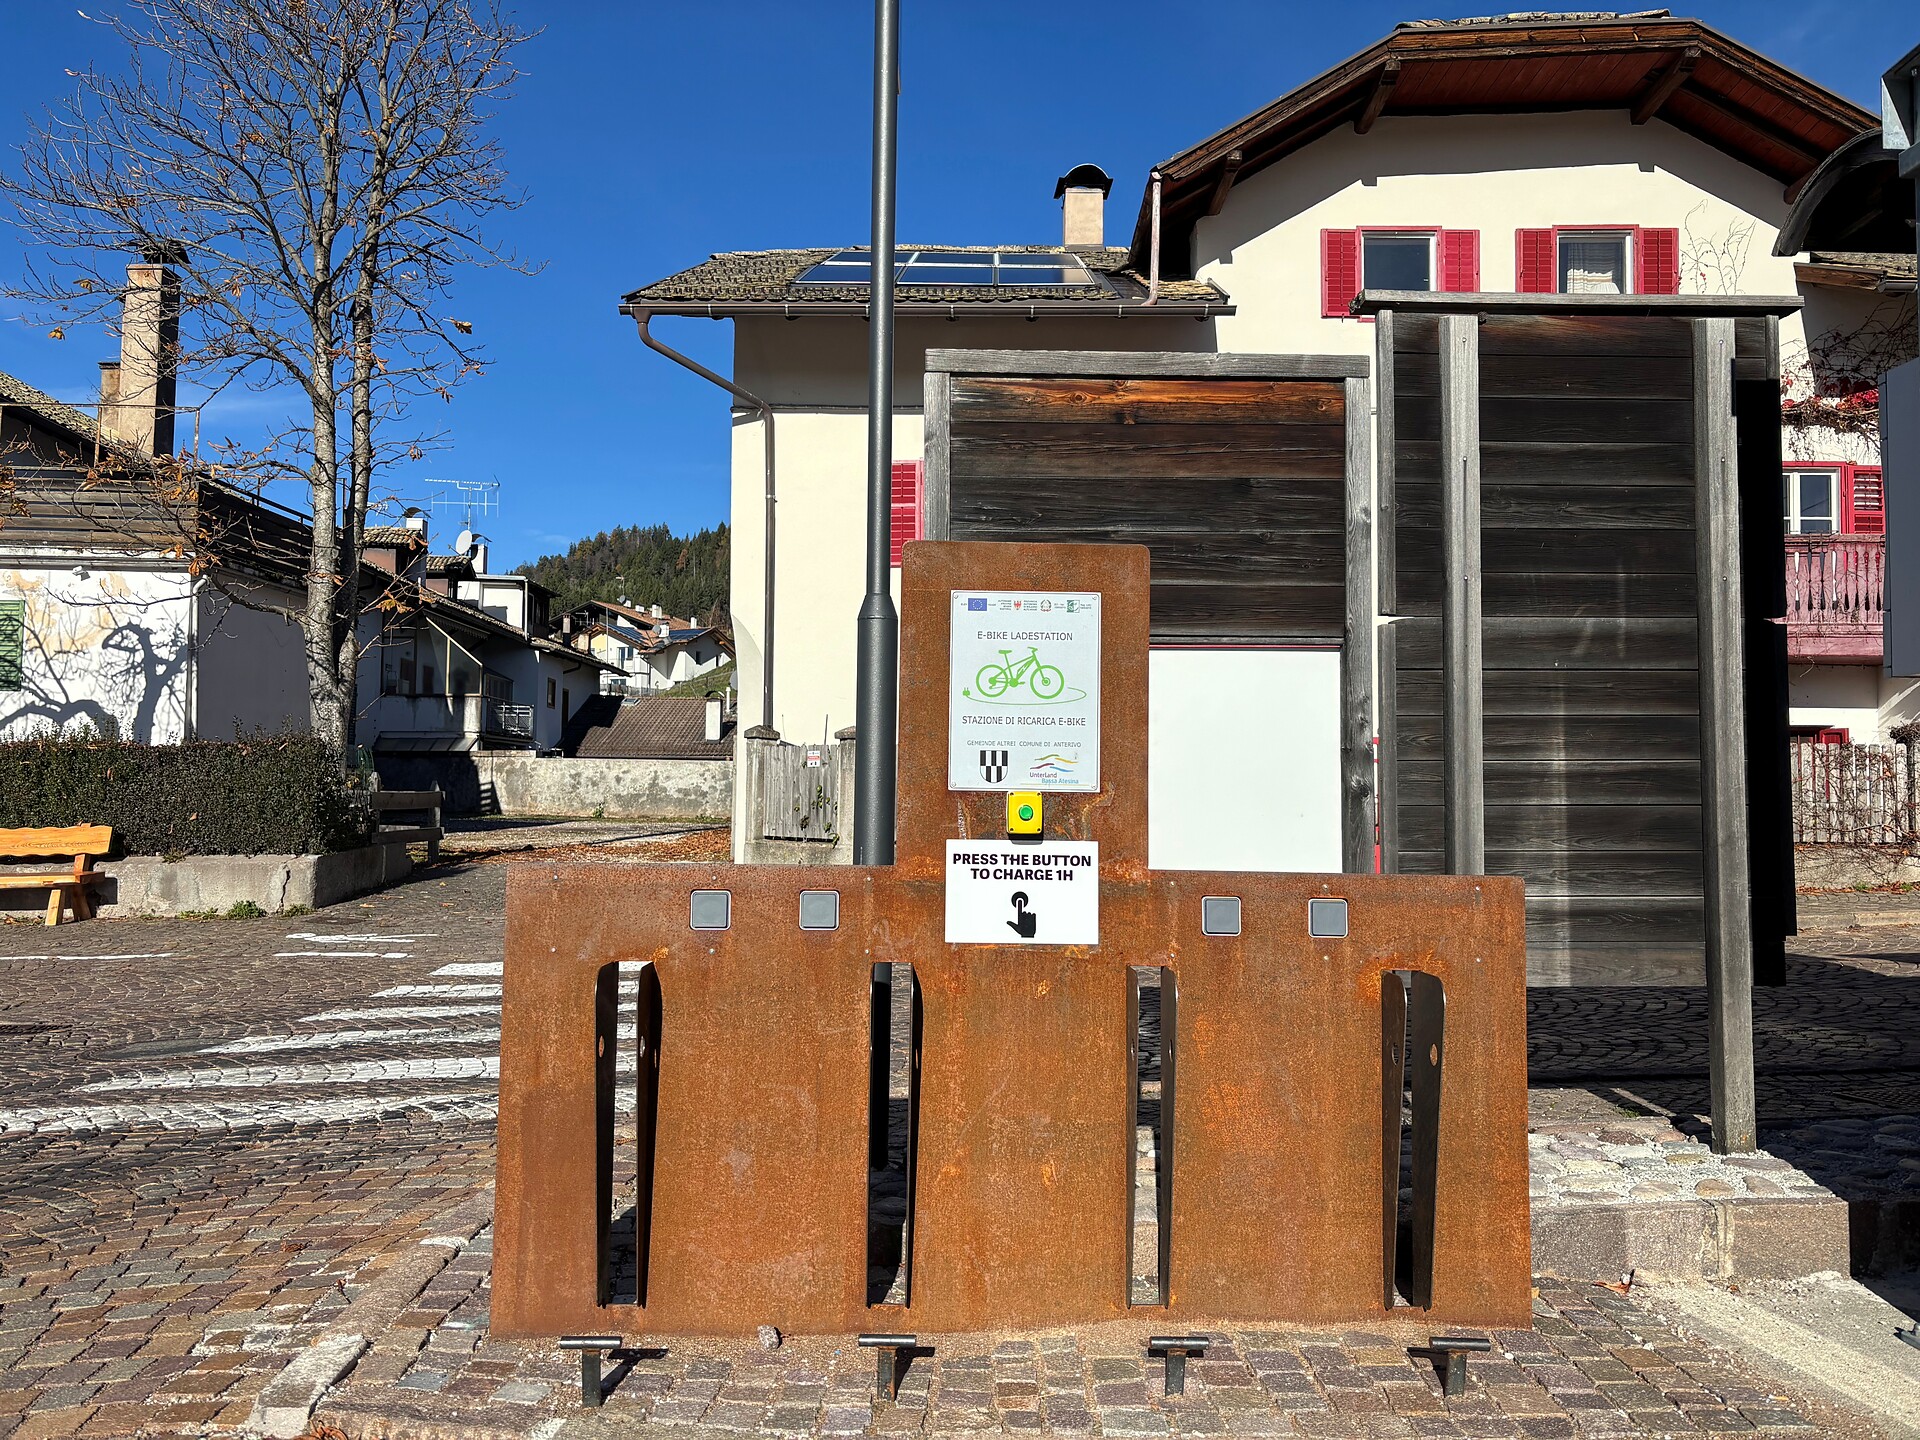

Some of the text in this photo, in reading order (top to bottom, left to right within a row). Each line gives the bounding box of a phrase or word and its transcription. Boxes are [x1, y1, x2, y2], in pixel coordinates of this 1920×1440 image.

[977, 631, 1073, 641] E-BIKE LADESTATION
[962, 715, 1086, 726] STAZIONE DI RICARICA E-BIKE
[953, 853, 1092, 867] PRESS THE BUTTON
[970, 868, 1073, 881] TO CHARGE 1H
